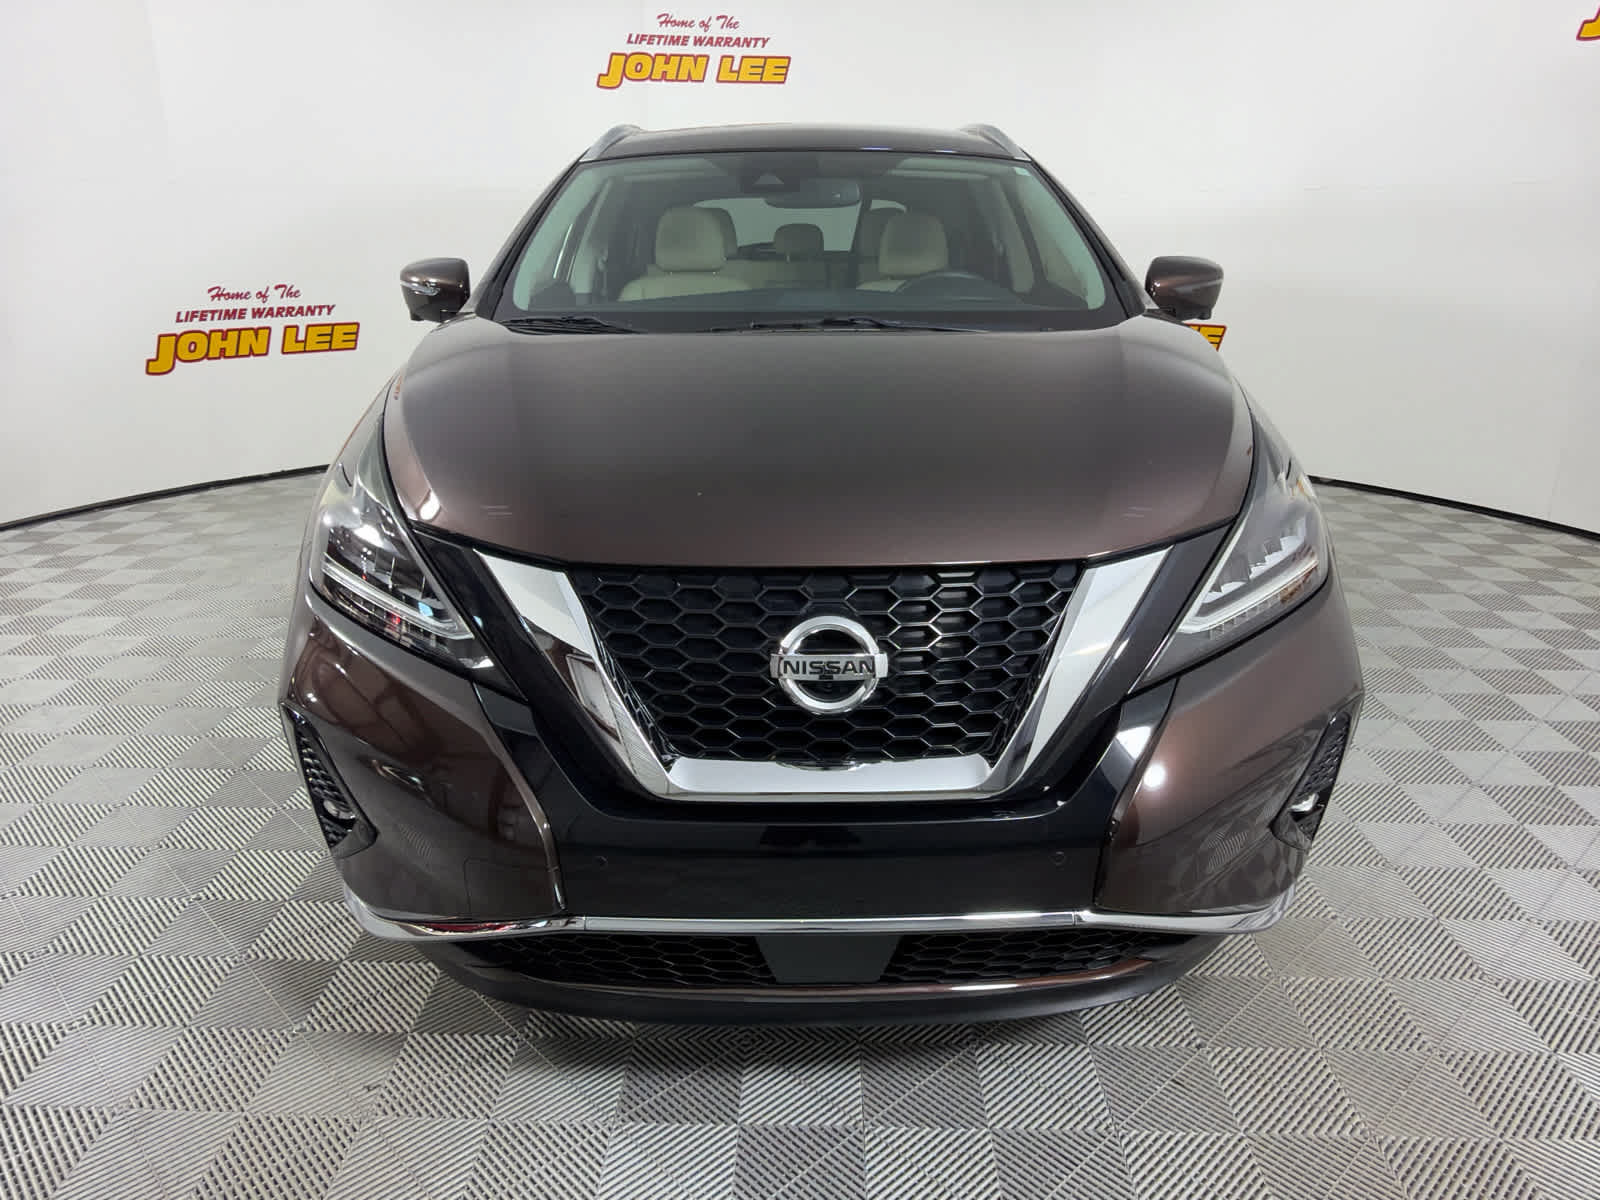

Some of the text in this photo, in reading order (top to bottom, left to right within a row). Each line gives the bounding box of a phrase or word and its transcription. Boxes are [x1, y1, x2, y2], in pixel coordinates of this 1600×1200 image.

[656, 13, 740, 32] Home of The
[626, 33, 770, 48] LIFETIME WARRANTY
[597, 51, 791, 89] JOHN LEE
[207, 284, 301, 303] Home of The
[175, 304, 336, 323] LIFETIME WARRANTY
[145, 321, 360, 376] JOHN LEE
[782, 660, 876, 675] NISSAN
